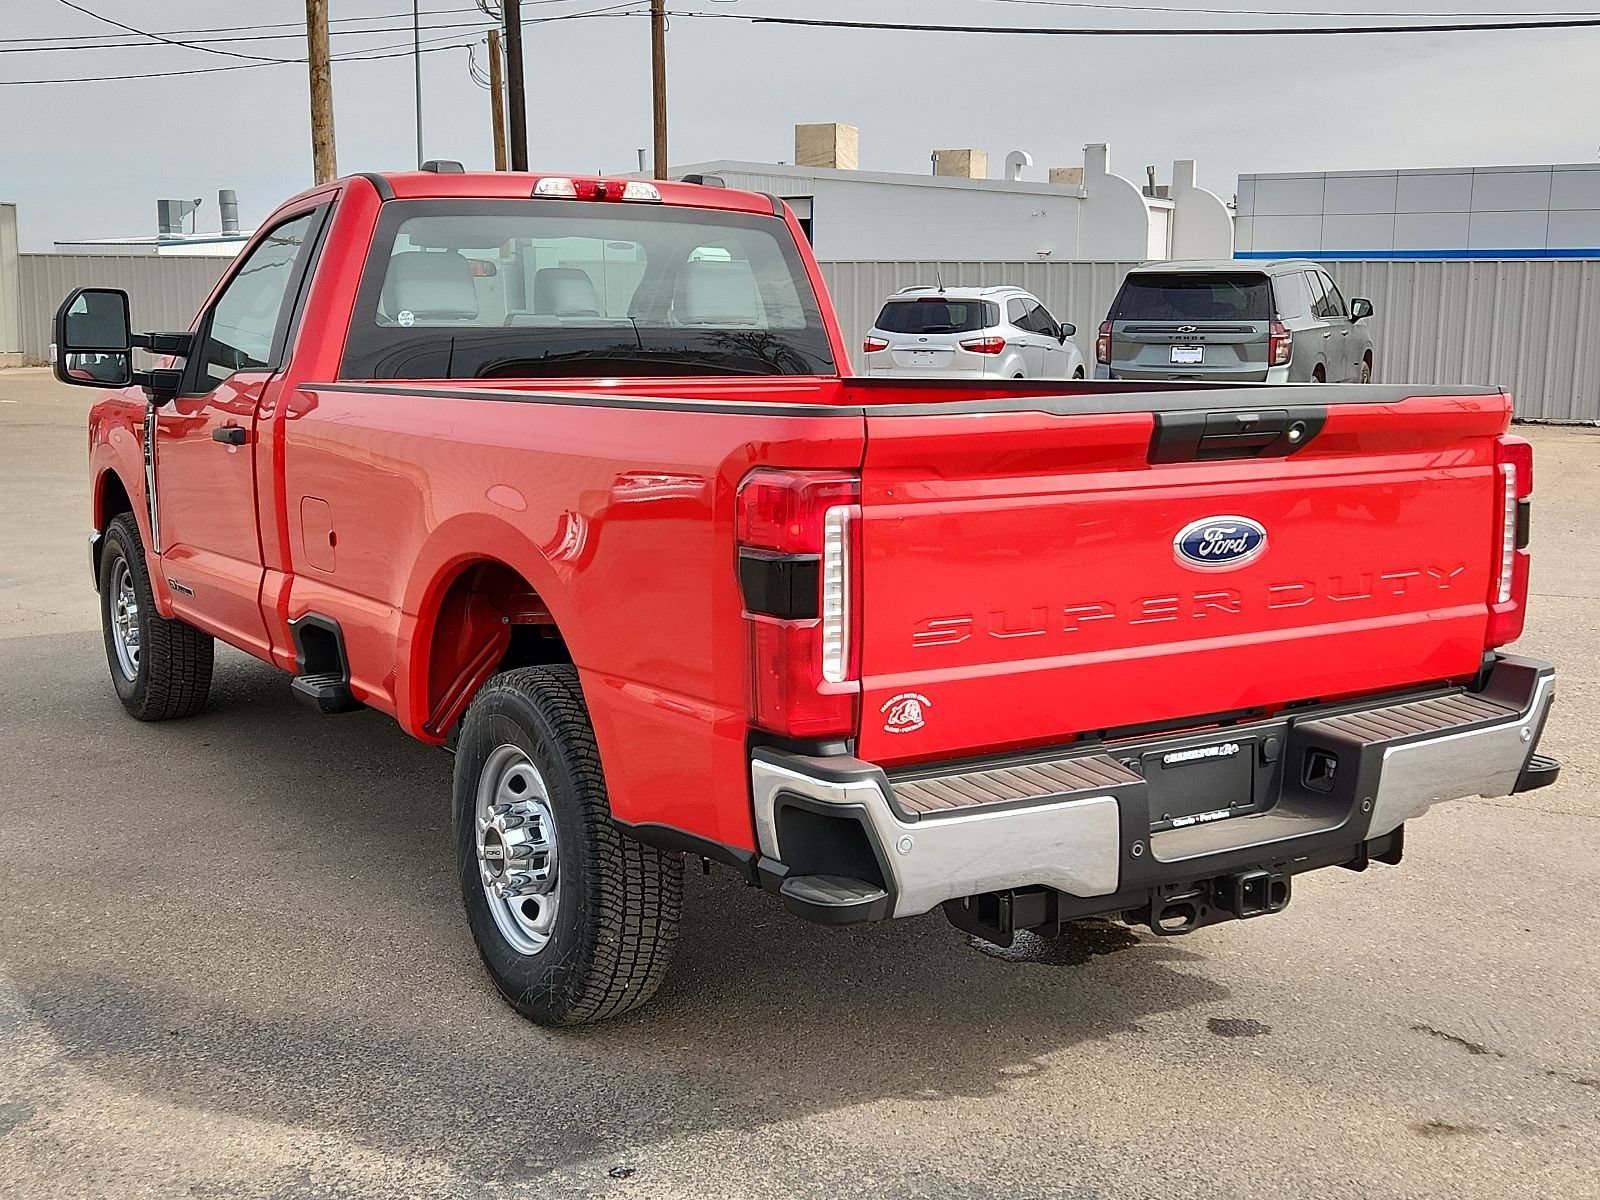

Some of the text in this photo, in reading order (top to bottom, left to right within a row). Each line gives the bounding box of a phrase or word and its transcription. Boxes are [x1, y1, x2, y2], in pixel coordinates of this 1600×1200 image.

[1199, 527, 1249, 556] Ford
[911, 563, 1466, 647] SUPER DUTY
